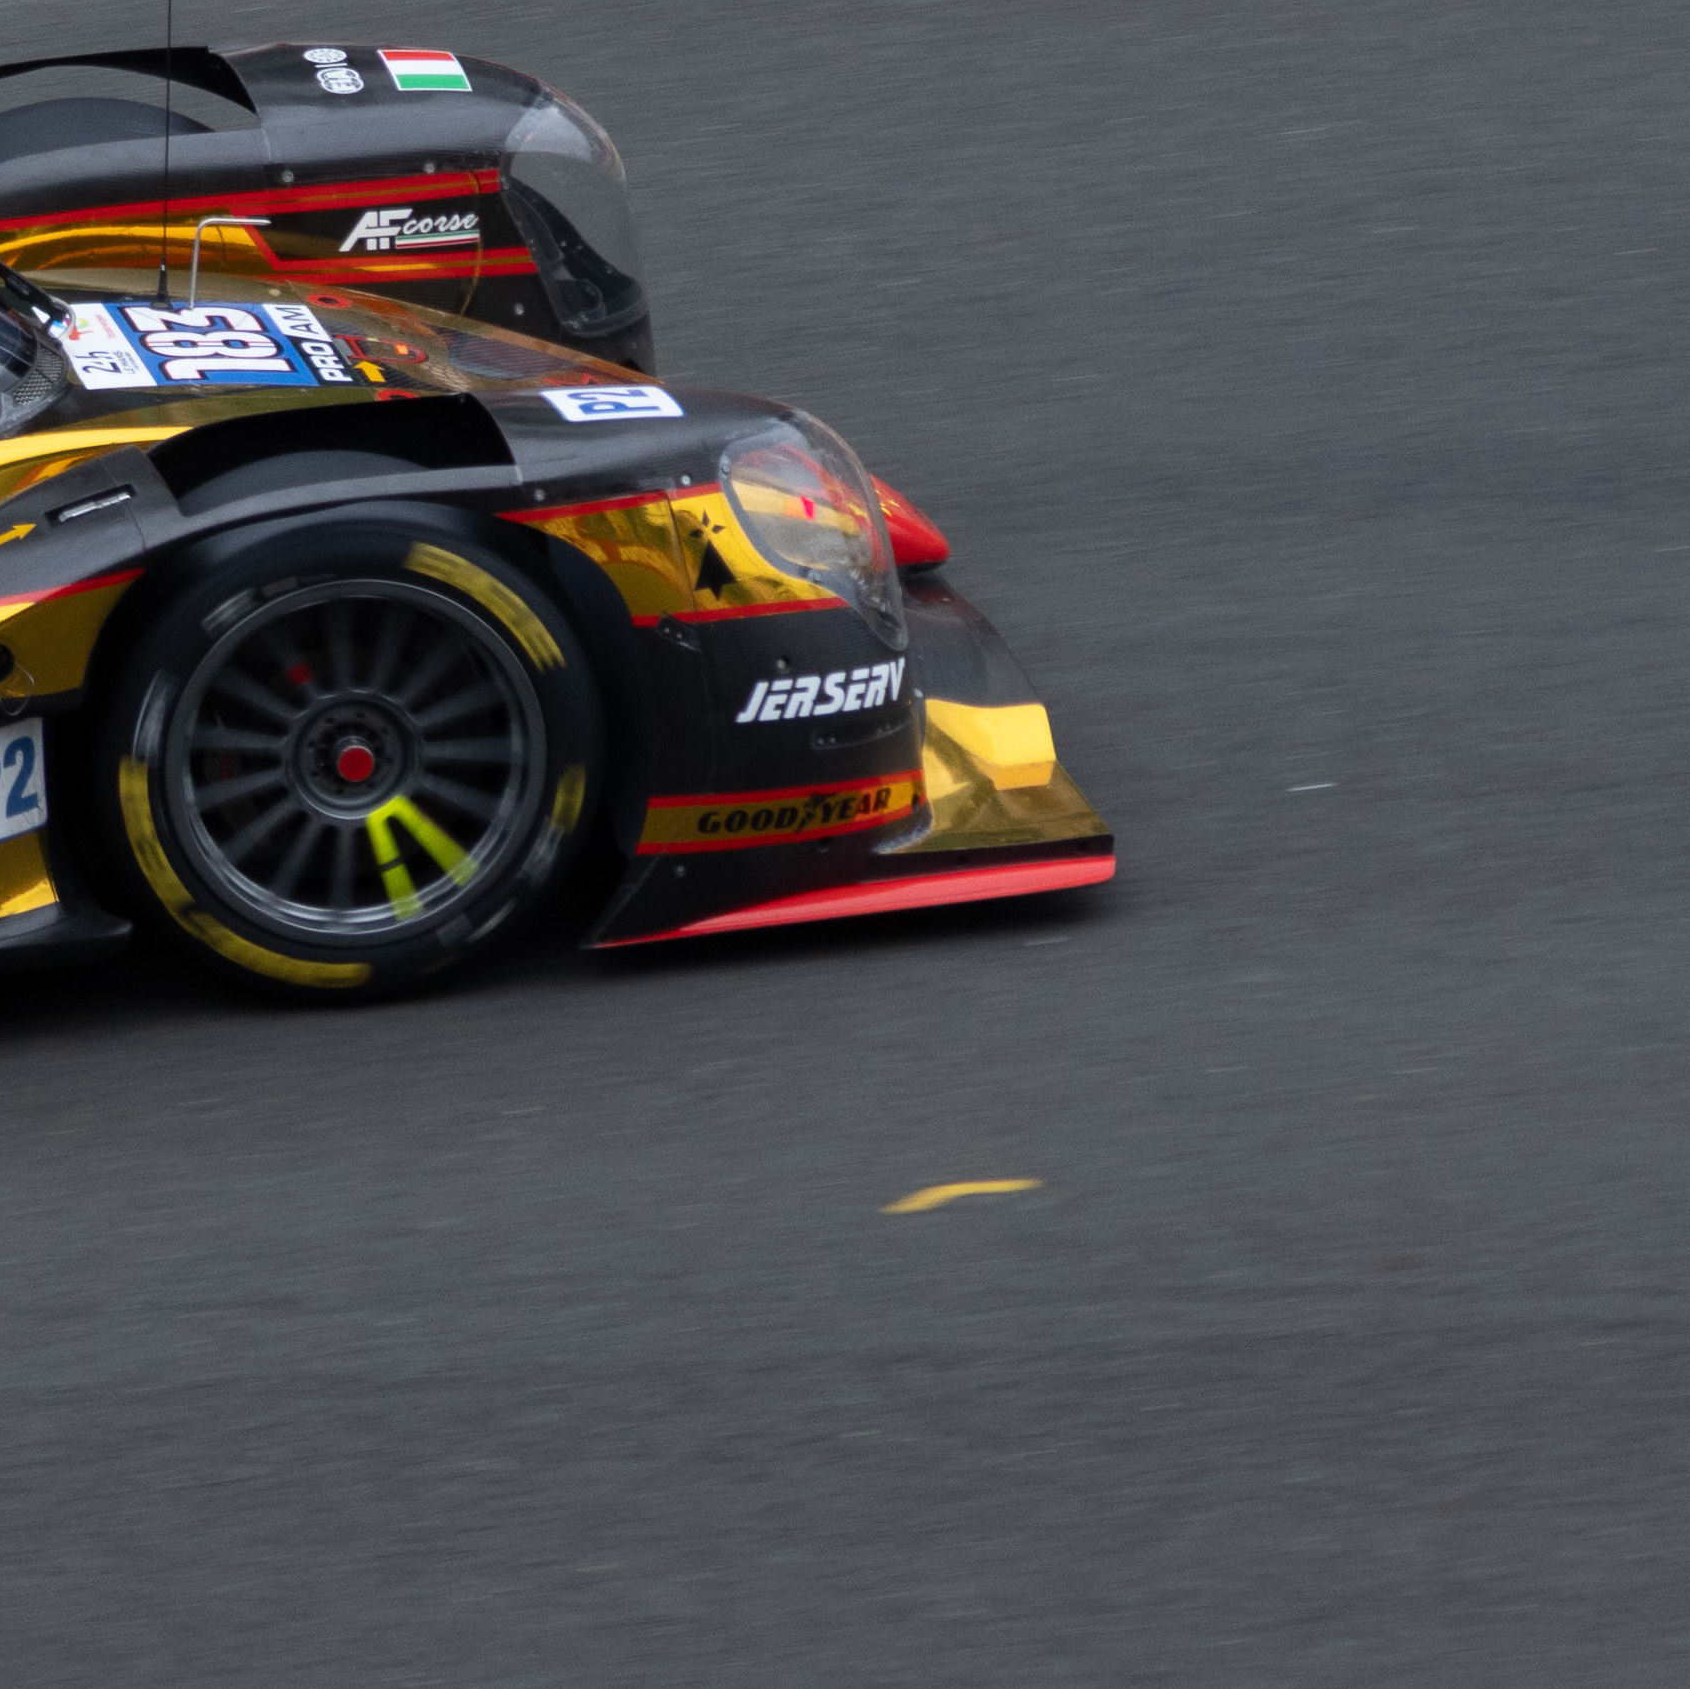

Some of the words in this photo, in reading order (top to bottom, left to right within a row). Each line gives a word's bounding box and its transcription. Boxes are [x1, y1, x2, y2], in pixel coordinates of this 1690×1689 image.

[403, 213, 479, 235] corse
[287, 304, 323, 336] AM
[120, 305, 297, 381] 183
[307, 341, 353, 382] PRO
[566, 387, 661, 416] P2
[735, 657, 906, 723] JERSERV
[698, 787, 892, 834] GOODYEAR
